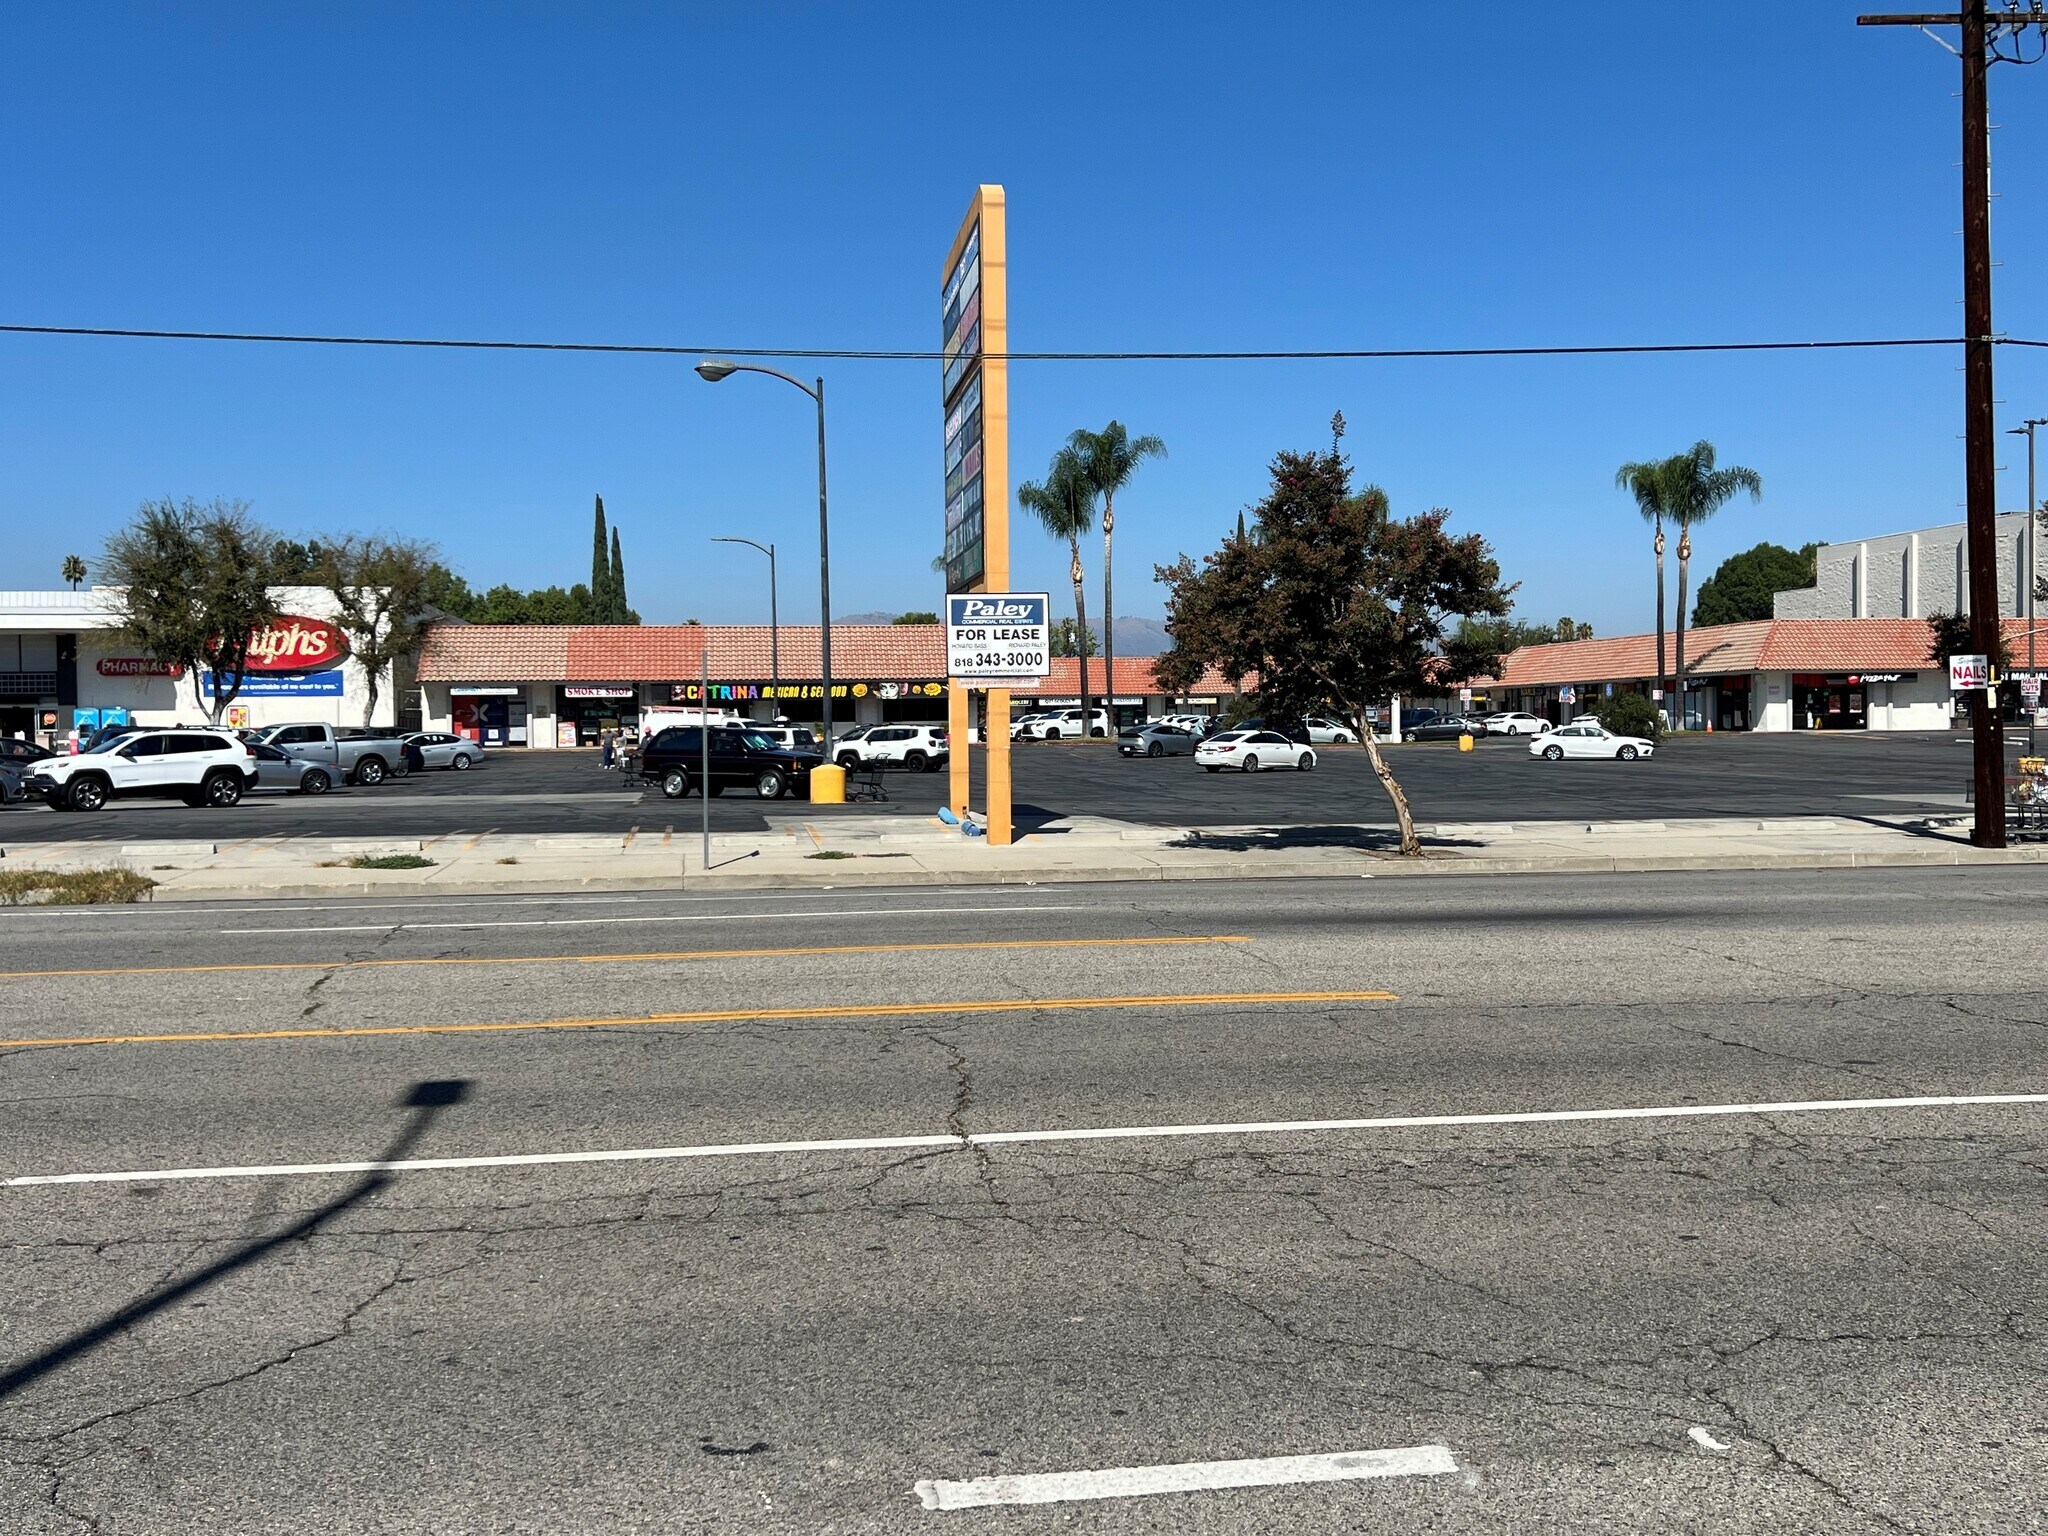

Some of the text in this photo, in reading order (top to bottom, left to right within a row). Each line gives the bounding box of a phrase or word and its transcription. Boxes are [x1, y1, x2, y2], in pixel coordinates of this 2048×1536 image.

[963, 600, 1033, 619] Paley
[956, 628, 1040, 641] FOR LEASE
[954, 652, 1043, 667] 818 343-3000
[1860, 674, 1902, 683] Pizza Hut
[1952, 665, 1987, 680] NAILS
[289, 683, 299, 691] no
[300, 683, 314, 691] cost
[314, 683, 322, 691] to
[567, 686, 632, 697] SMOKE SHOP
[687, 685, 758, 701] CATRINA
[801, 685, 809, 699] &
[2021, 684, 2039, 692] CUTS
